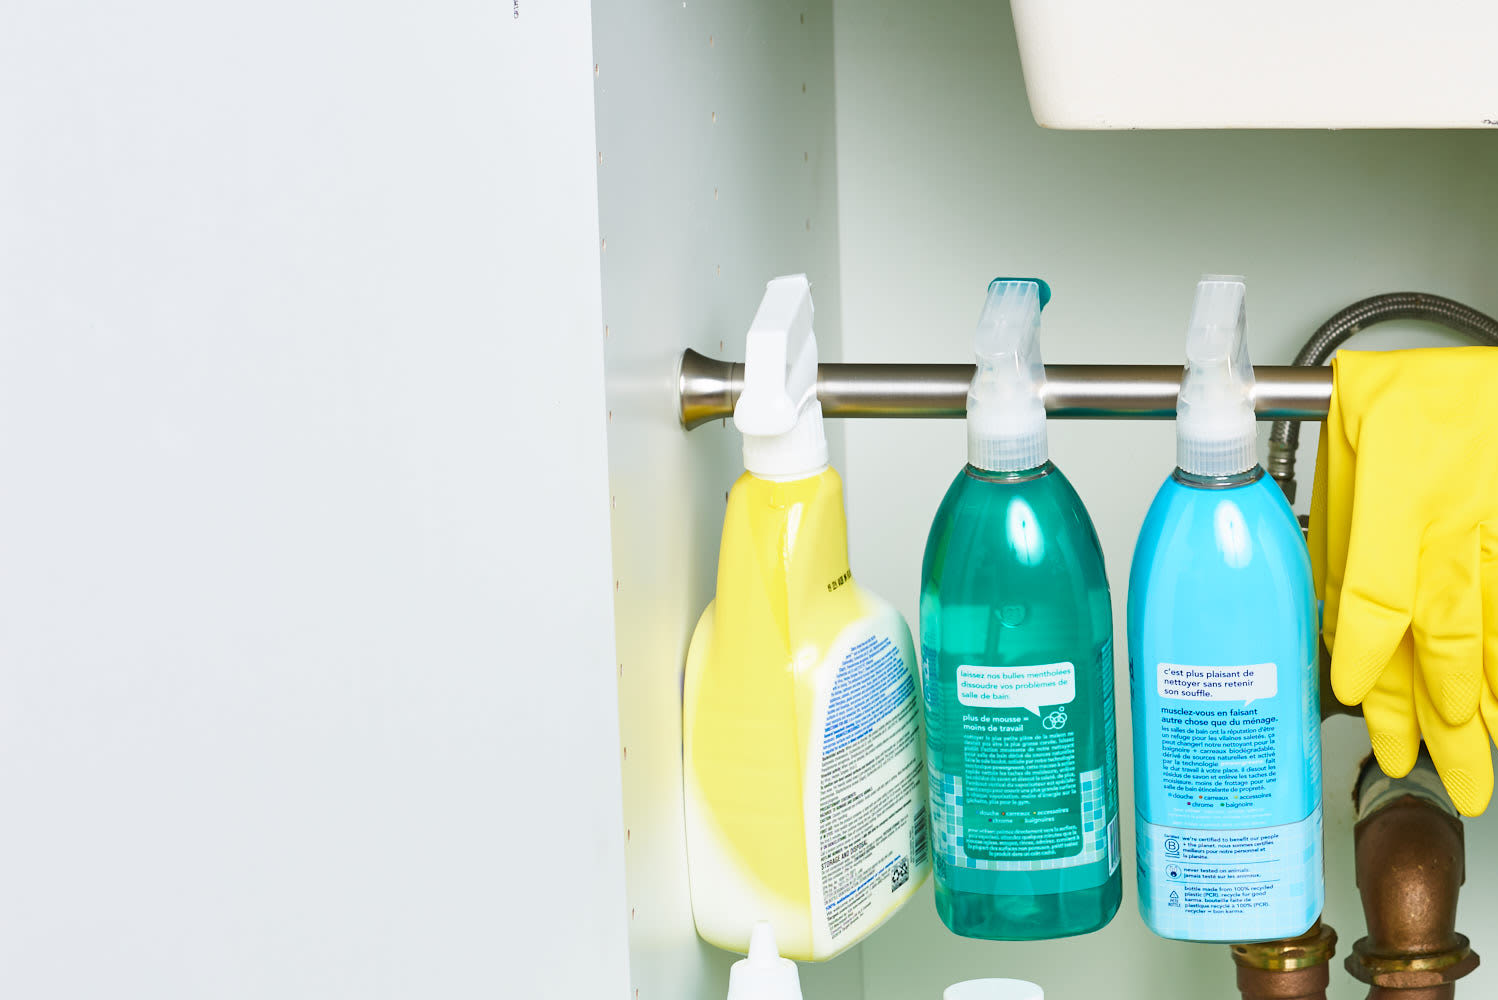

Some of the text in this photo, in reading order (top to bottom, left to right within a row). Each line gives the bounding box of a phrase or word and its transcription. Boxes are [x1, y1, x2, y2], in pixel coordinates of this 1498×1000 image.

[960, 671, 984, 679] laissez
[1186, 671, 1204, 681] plus
[1207, 670, 1240, 681] plaisant
[961, 681, 998, 689] dissoudre
[1164, 680, 1200, 688] nettoyer
[1161, 708, 1214, 716] musclez-vous
[963, 714, 978, 723] plus
[1211, 719, 1227, 727] que
[1243, 716, 1278, 725] ménage.
